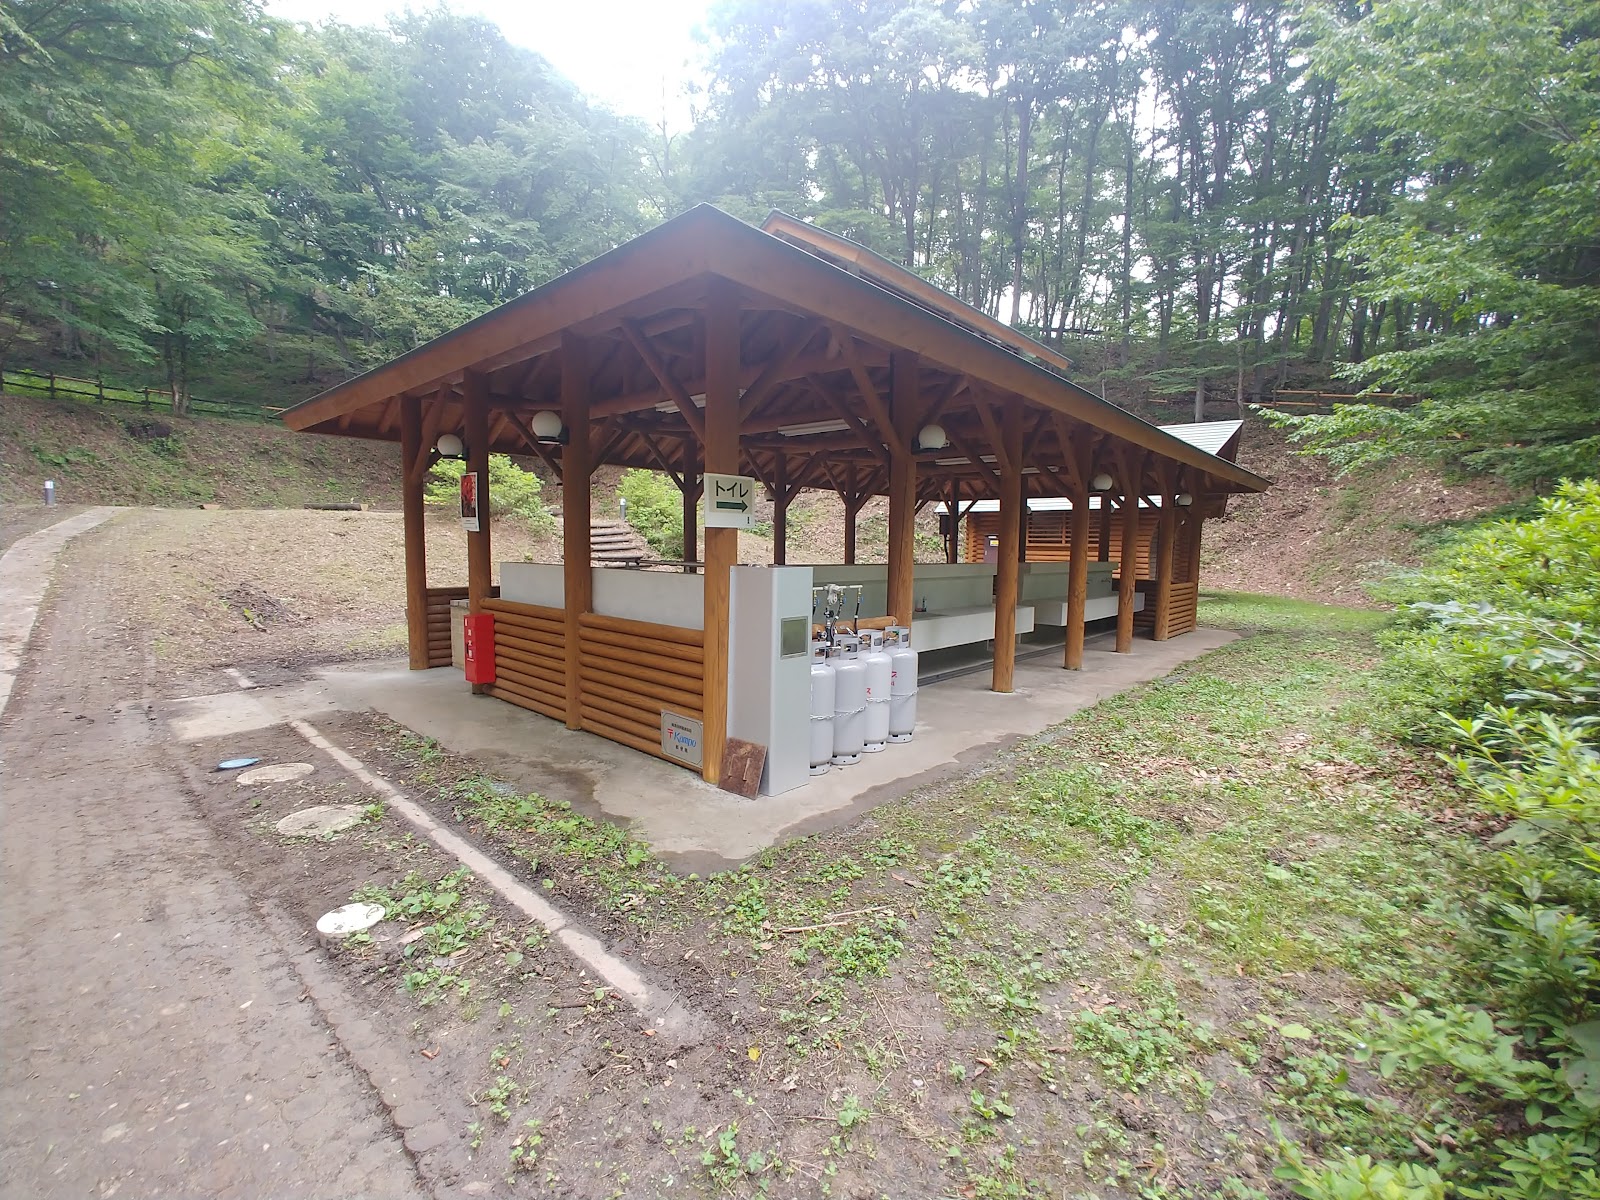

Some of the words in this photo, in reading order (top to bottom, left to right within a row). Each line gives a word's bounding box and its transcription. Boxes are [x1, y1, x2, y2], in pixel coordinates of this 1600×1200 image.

[715, 480, 749, 498] トイレ
[673, 731, 697, 748] Kampo
